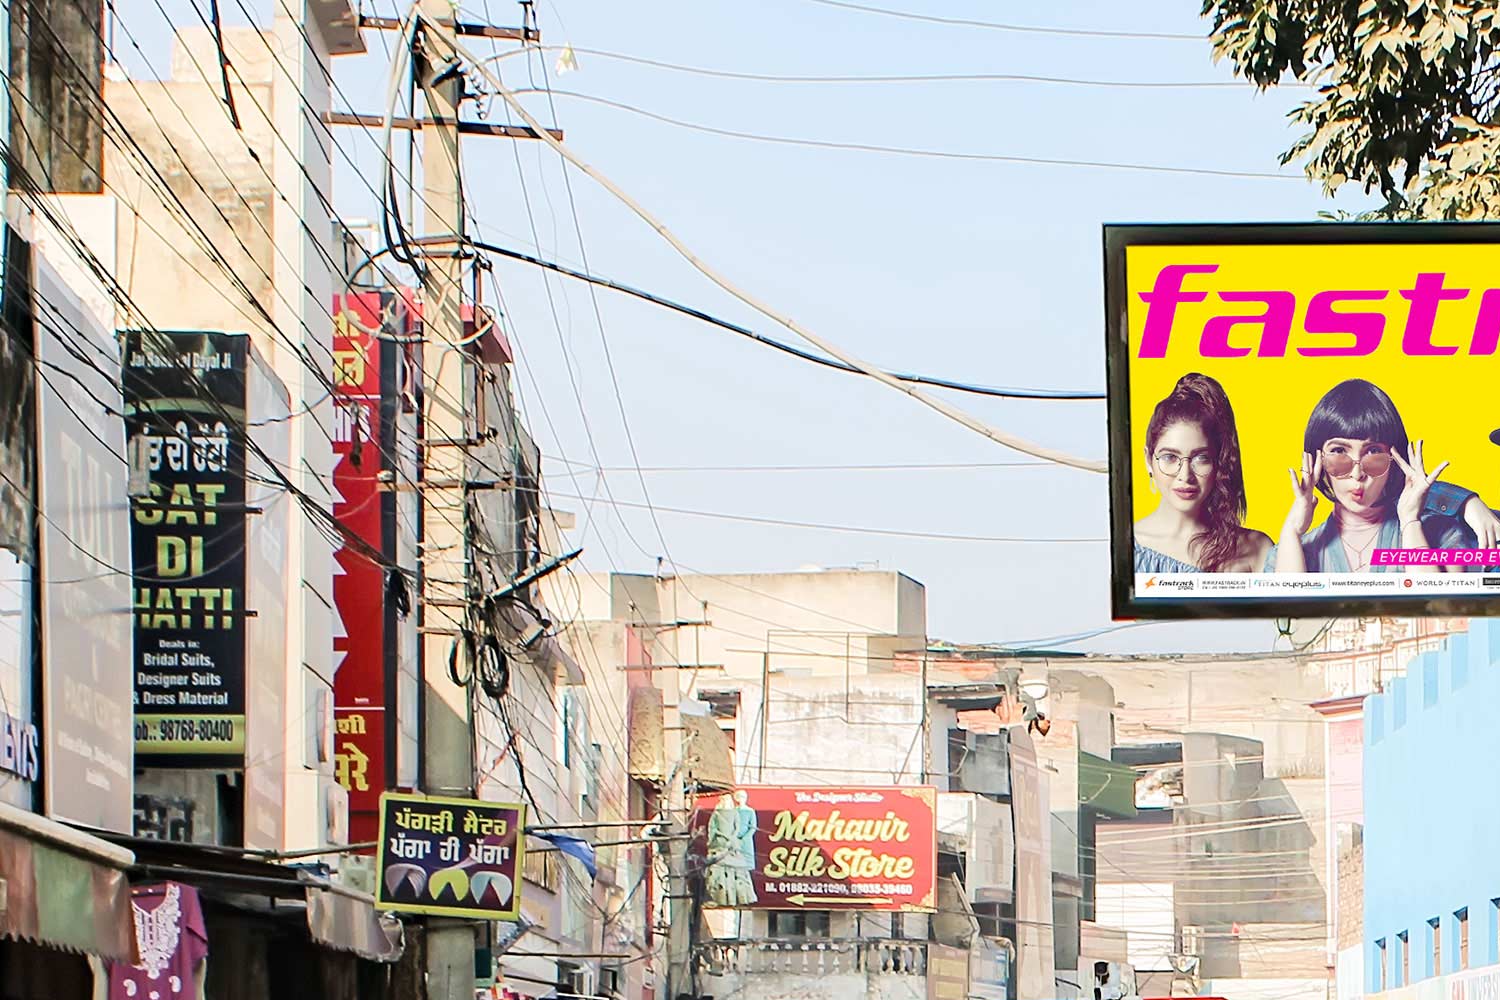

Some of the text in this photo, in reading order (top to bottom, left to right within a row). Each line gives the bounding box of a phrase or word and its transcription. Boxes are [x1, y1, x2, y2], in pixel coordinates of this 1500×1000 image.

[135, 482, 225, 525] SAT
[156, 536, 204, 578] DI
[1379, 551, 1449, 563] EYEWEAR
[1453, 551, 1483, 563] FOR
[143, 653, 215, 669] Bridal Suits,
[137, 672, 222, 687] Designer Suits
[143, 692, 176, 704] Dress
[178, 691, 229, 705] Material
[135, 719, 233, 741] ob.: 98768-80400
[395, 807, 454, 835] ਪੱਗੜੀ
[768, 810, 911, 842] Mahavir
[439, 836, 460, 862] ਹੀ
[763, 846, 915, 880] Silk Store
